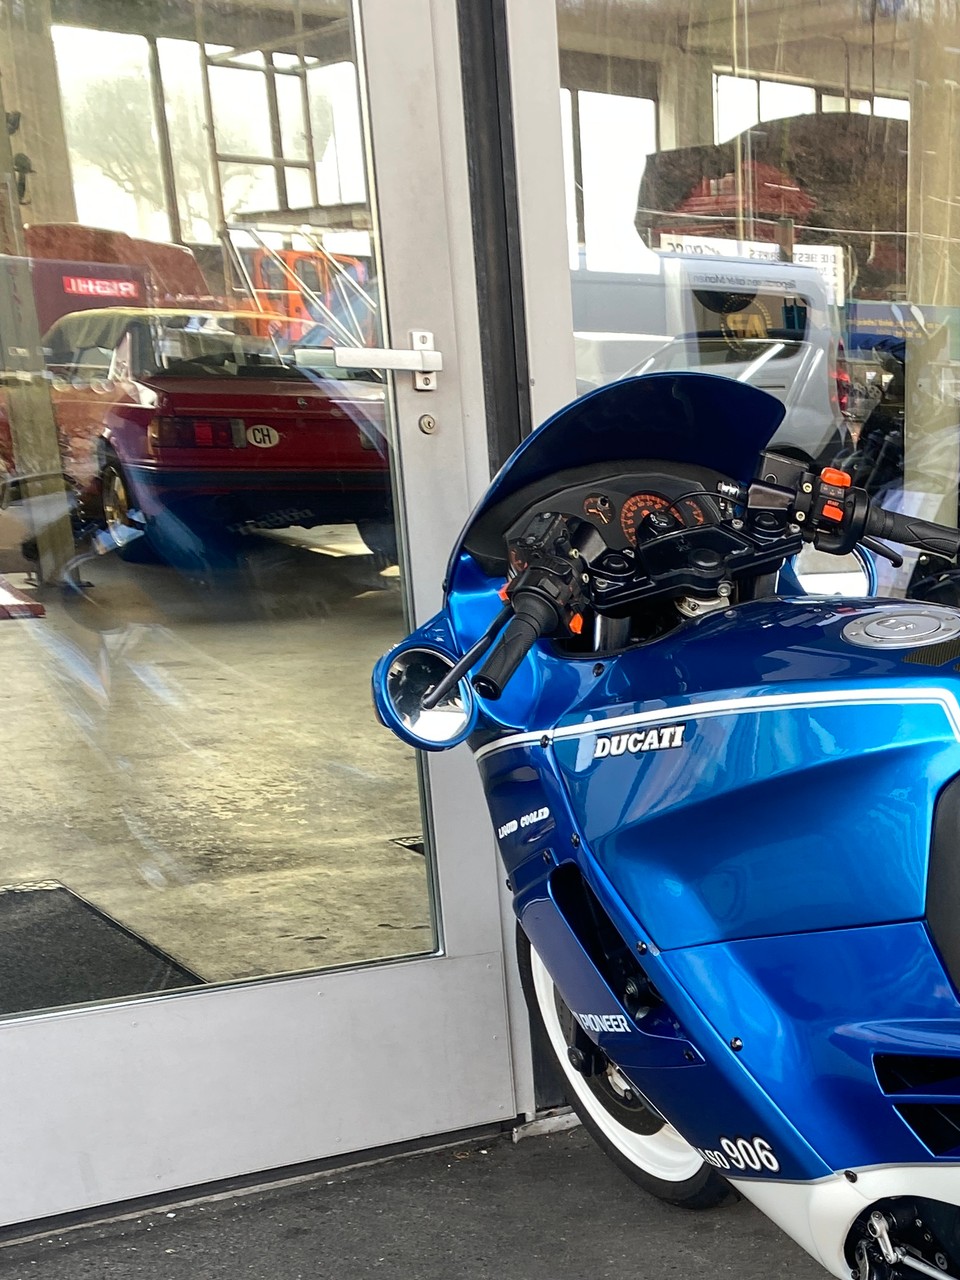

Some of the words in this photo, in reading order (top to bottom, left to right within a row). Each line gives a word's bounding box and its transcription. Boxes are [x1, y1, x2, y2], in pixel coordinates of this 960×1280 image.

[252, 428, 272, 444] CH
[594, 725, 686, 758] DUCATI
[498, 820, 518, 839] LIQUID
[520, 807, 549, 828] COOLED
[578, 1013, 632, 1032] PIONEER
[720, 1137, 779, 1173] 906
